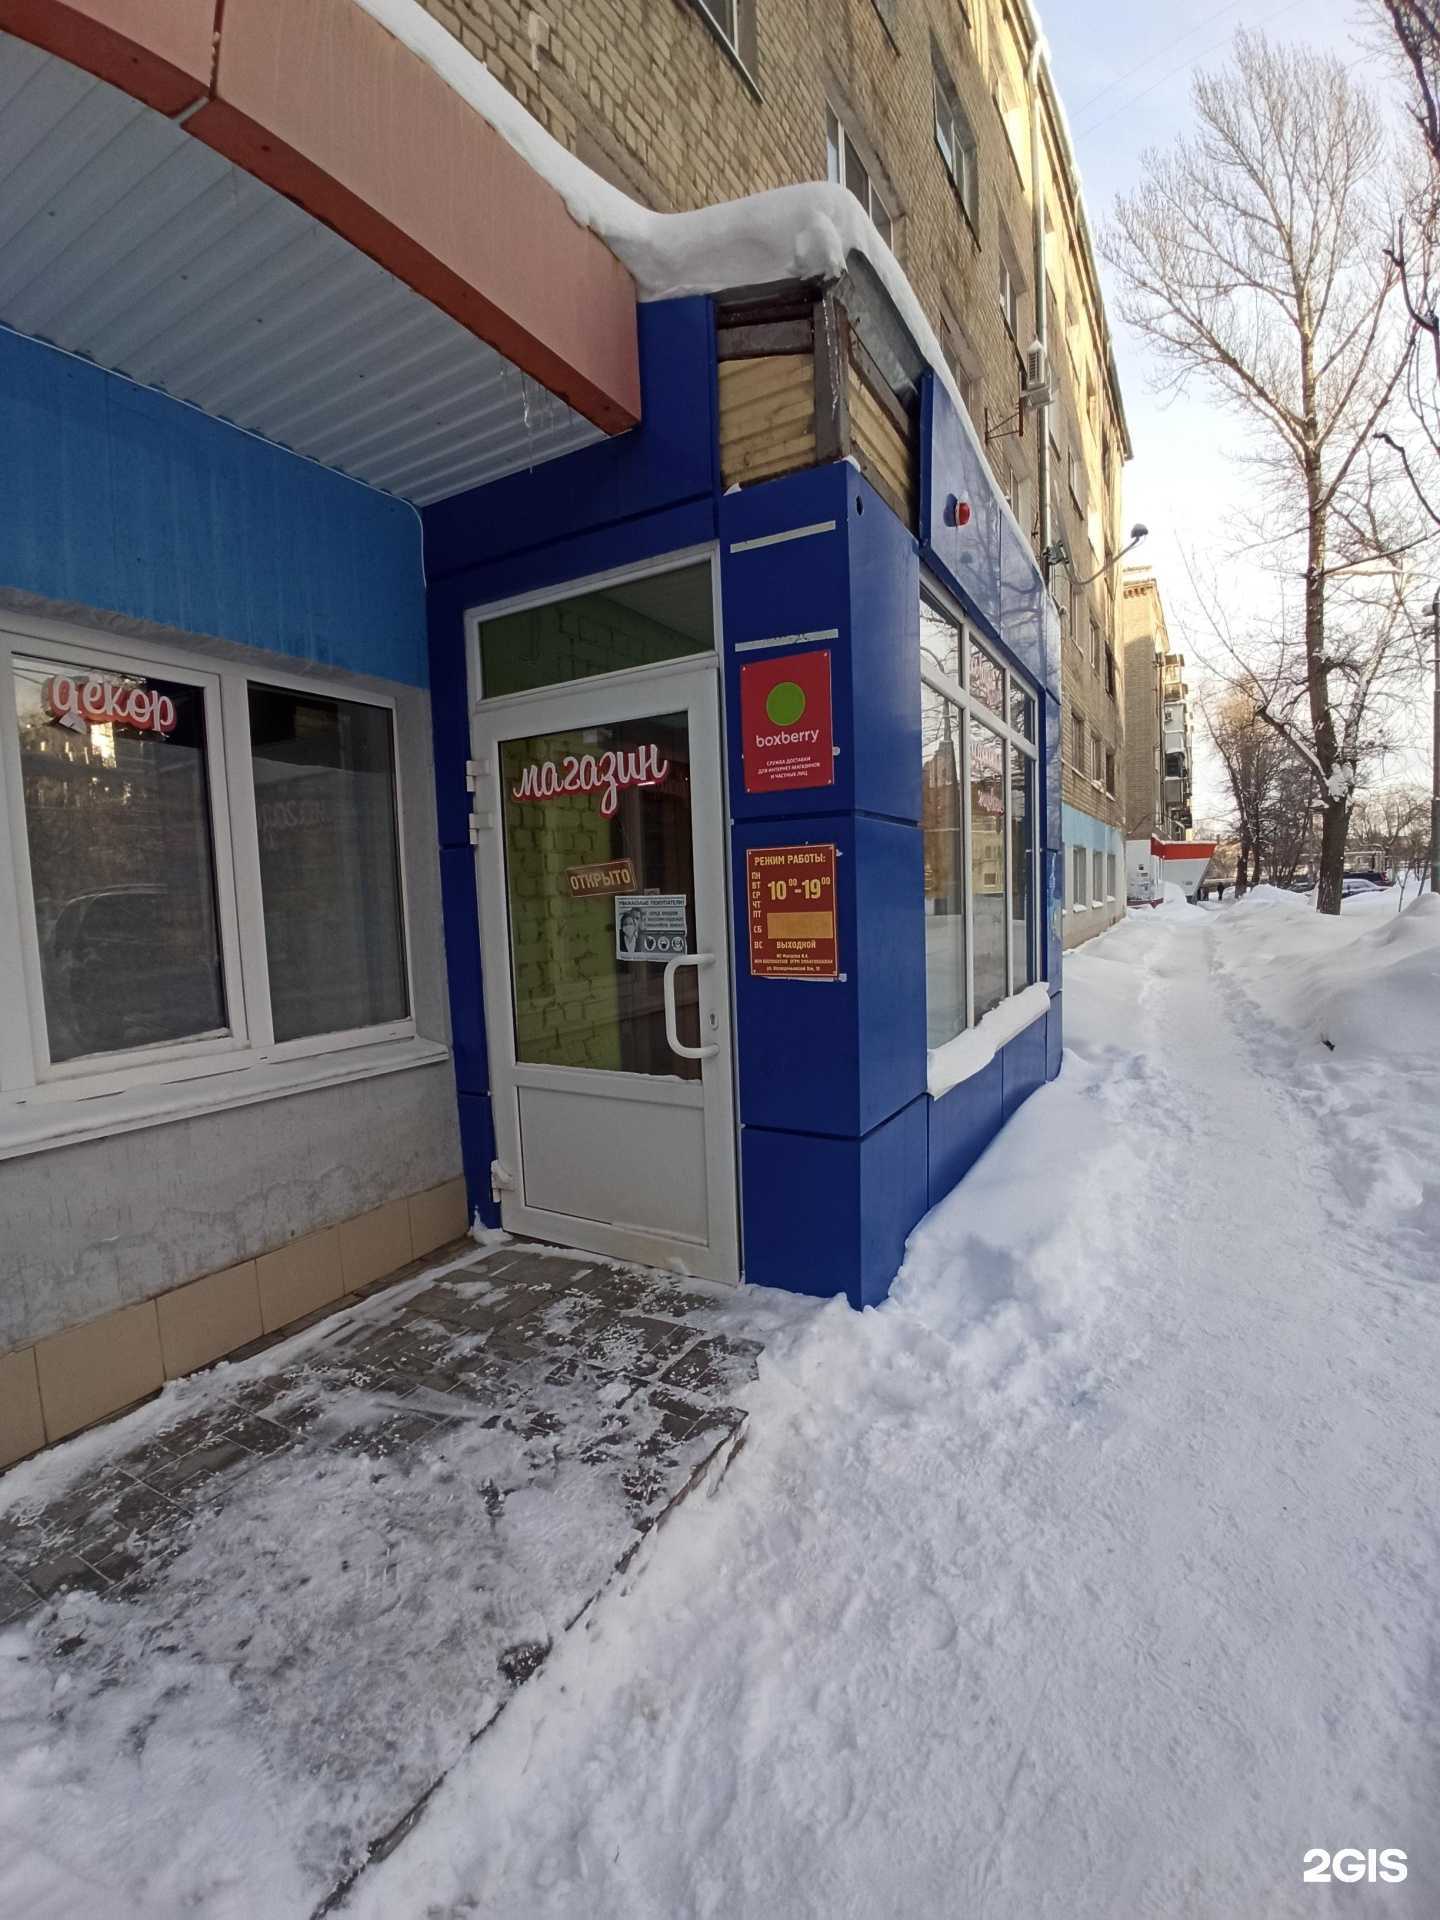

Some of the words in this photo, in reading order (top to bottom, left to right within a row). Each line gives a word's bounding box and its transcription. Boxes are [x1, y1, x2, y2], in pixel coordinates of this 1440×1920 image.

[51, 674, 176, 733] декор
[756, 729, 819, 748] boxberry
[766, 759, 786, 767] СЛУЖБА
[786, 756, 811, 765] ДОСТАВКИ
[512, 743, 668, 815] магазин
[754, 856, 785, 866] РЕЖИМ
[787, 853, 826, 864] РАБОТЫ:
[569, 867, 631, 891] ОТКРЫТО
[752, 871, 761, 880] ПН
[752, 881, 761, 890] ВТ
[752, 891, 761, 900] СР
[752, 900, 761, 909] ЧТ
[753, 910, 762, 919] ПТ
[753, 925, 762, 934] СБ
[754, 941, 763, 950] ВС
[776, 940, 816, 950] ВЫХОДНОЙ
